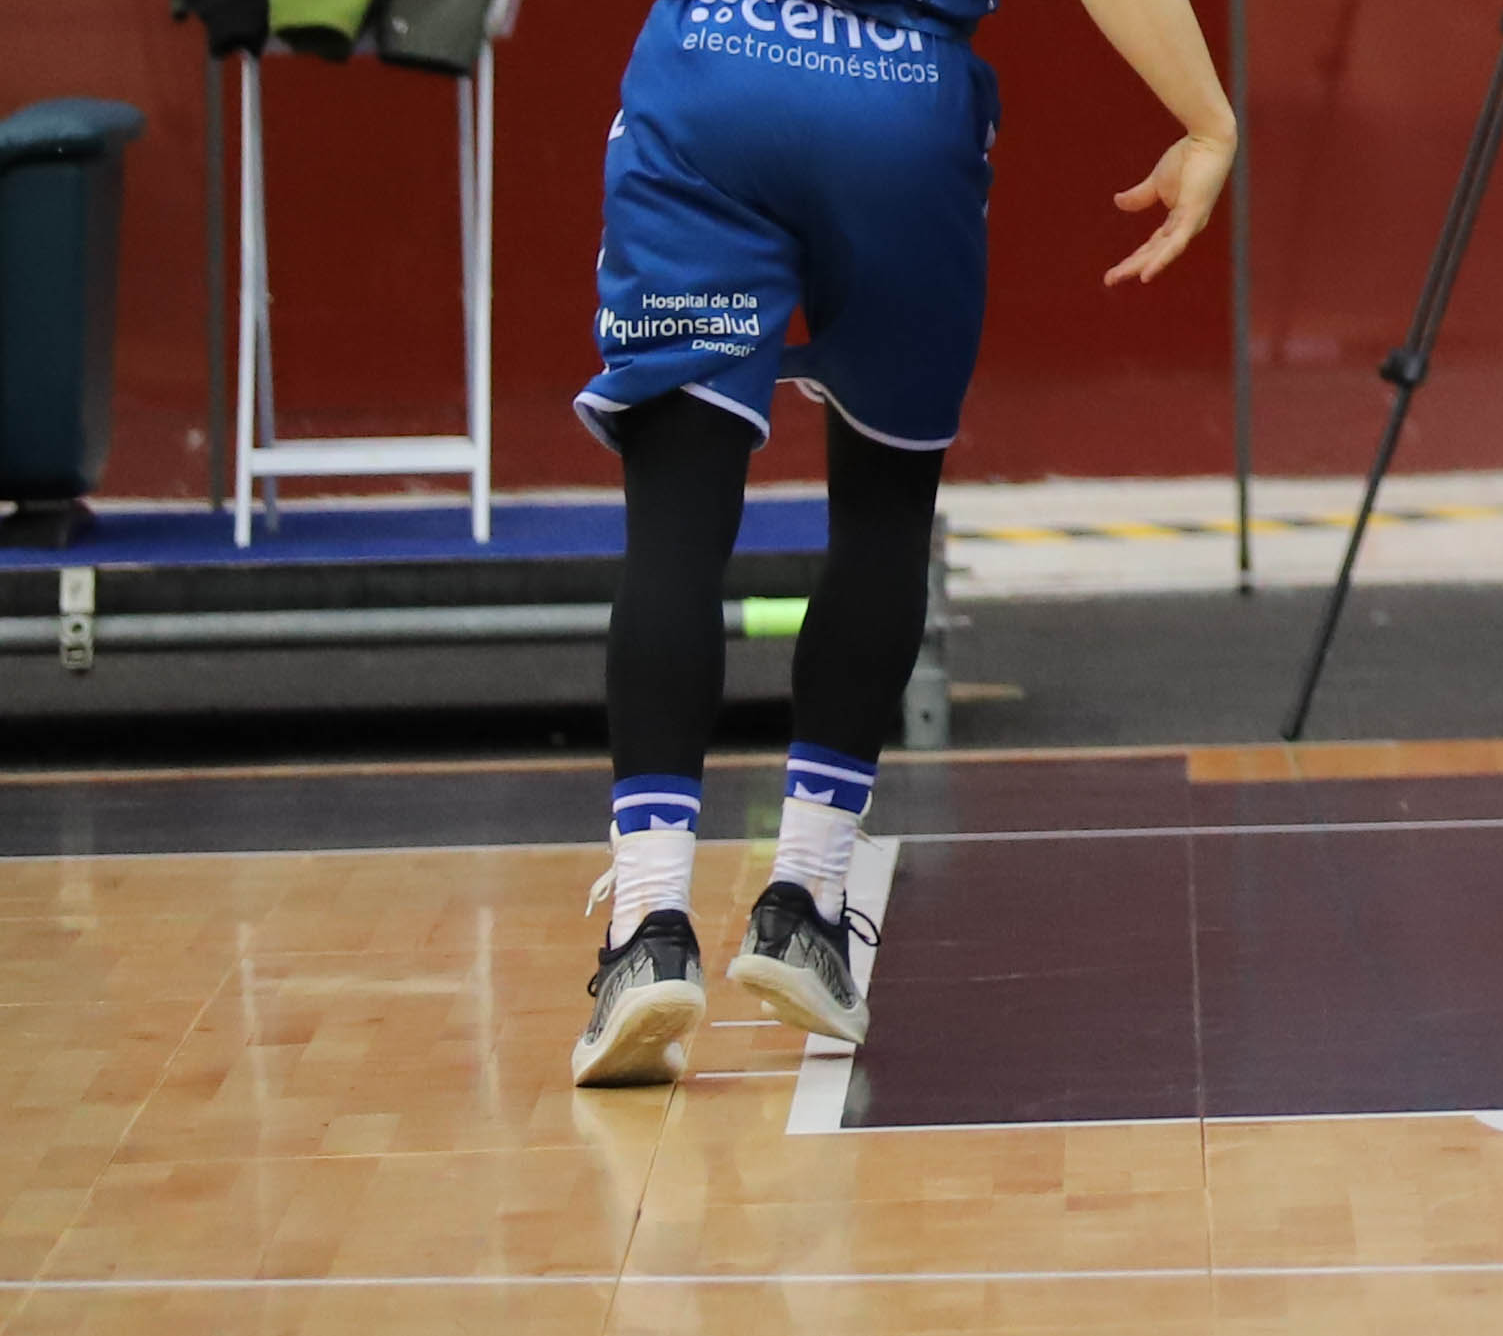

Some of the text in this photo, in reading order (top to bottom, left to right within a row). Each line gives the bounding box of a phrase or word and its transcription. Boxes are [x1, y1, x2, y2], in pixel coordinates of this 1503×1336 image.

[682, 28, 939, 83] electrodomésticos
[642, 293, 707, 311] Hospital
[711, 293, 729, 308] de
